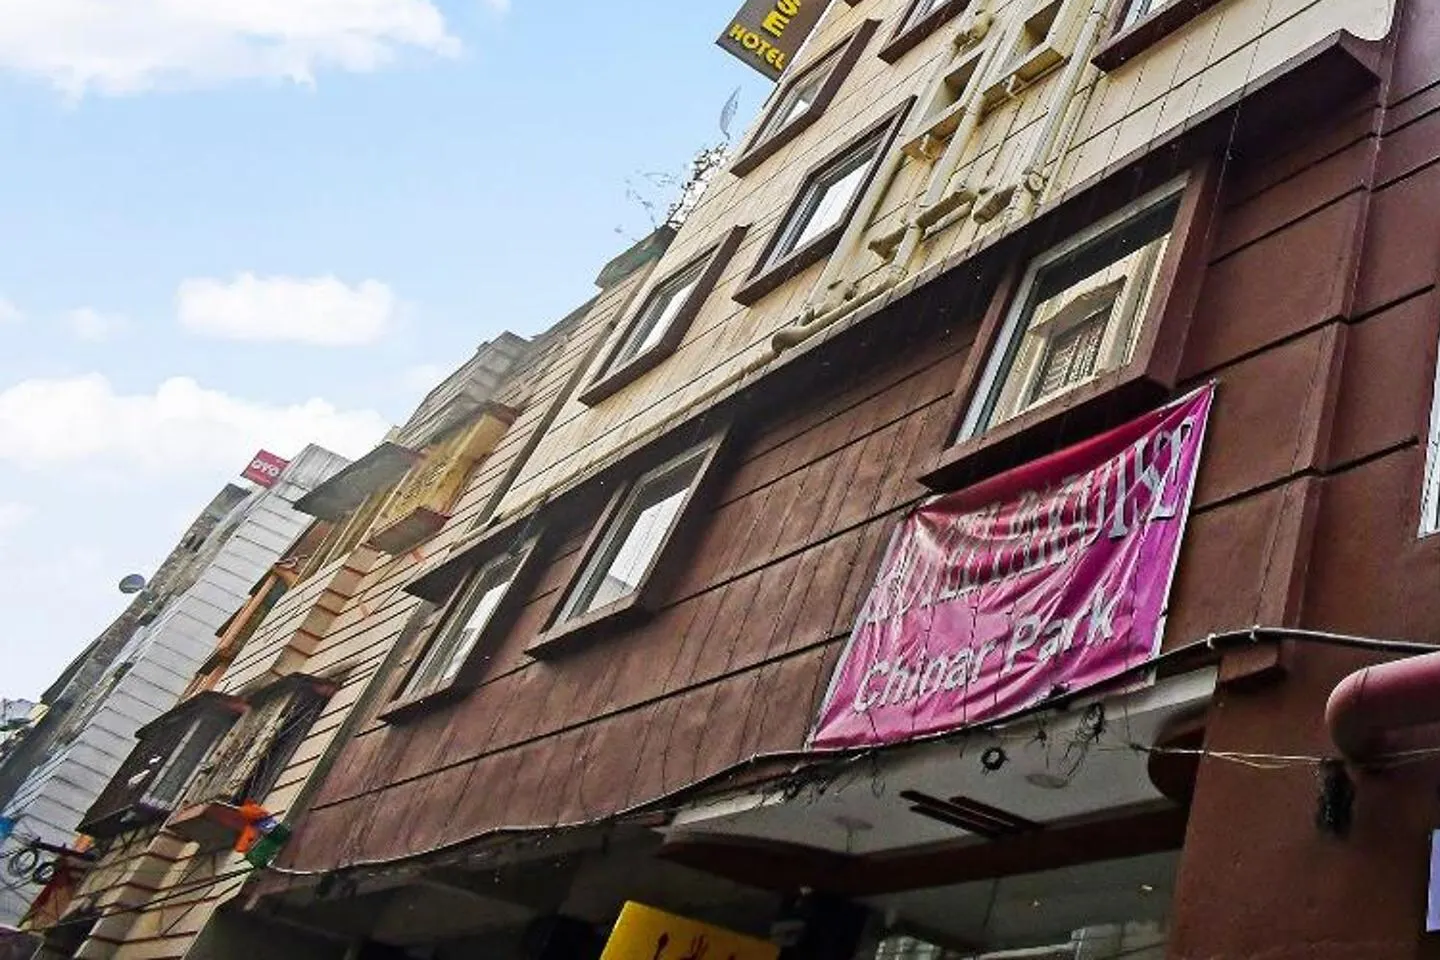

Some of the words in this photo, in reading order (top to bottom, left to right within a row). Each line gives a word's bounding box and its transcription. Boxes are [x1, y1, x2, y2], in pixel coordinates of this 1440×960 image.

[729, 23, 786, 70] HOTEL
[250, 459, 281, 477] OYO
[1002, 583, 1114, 675] Park
